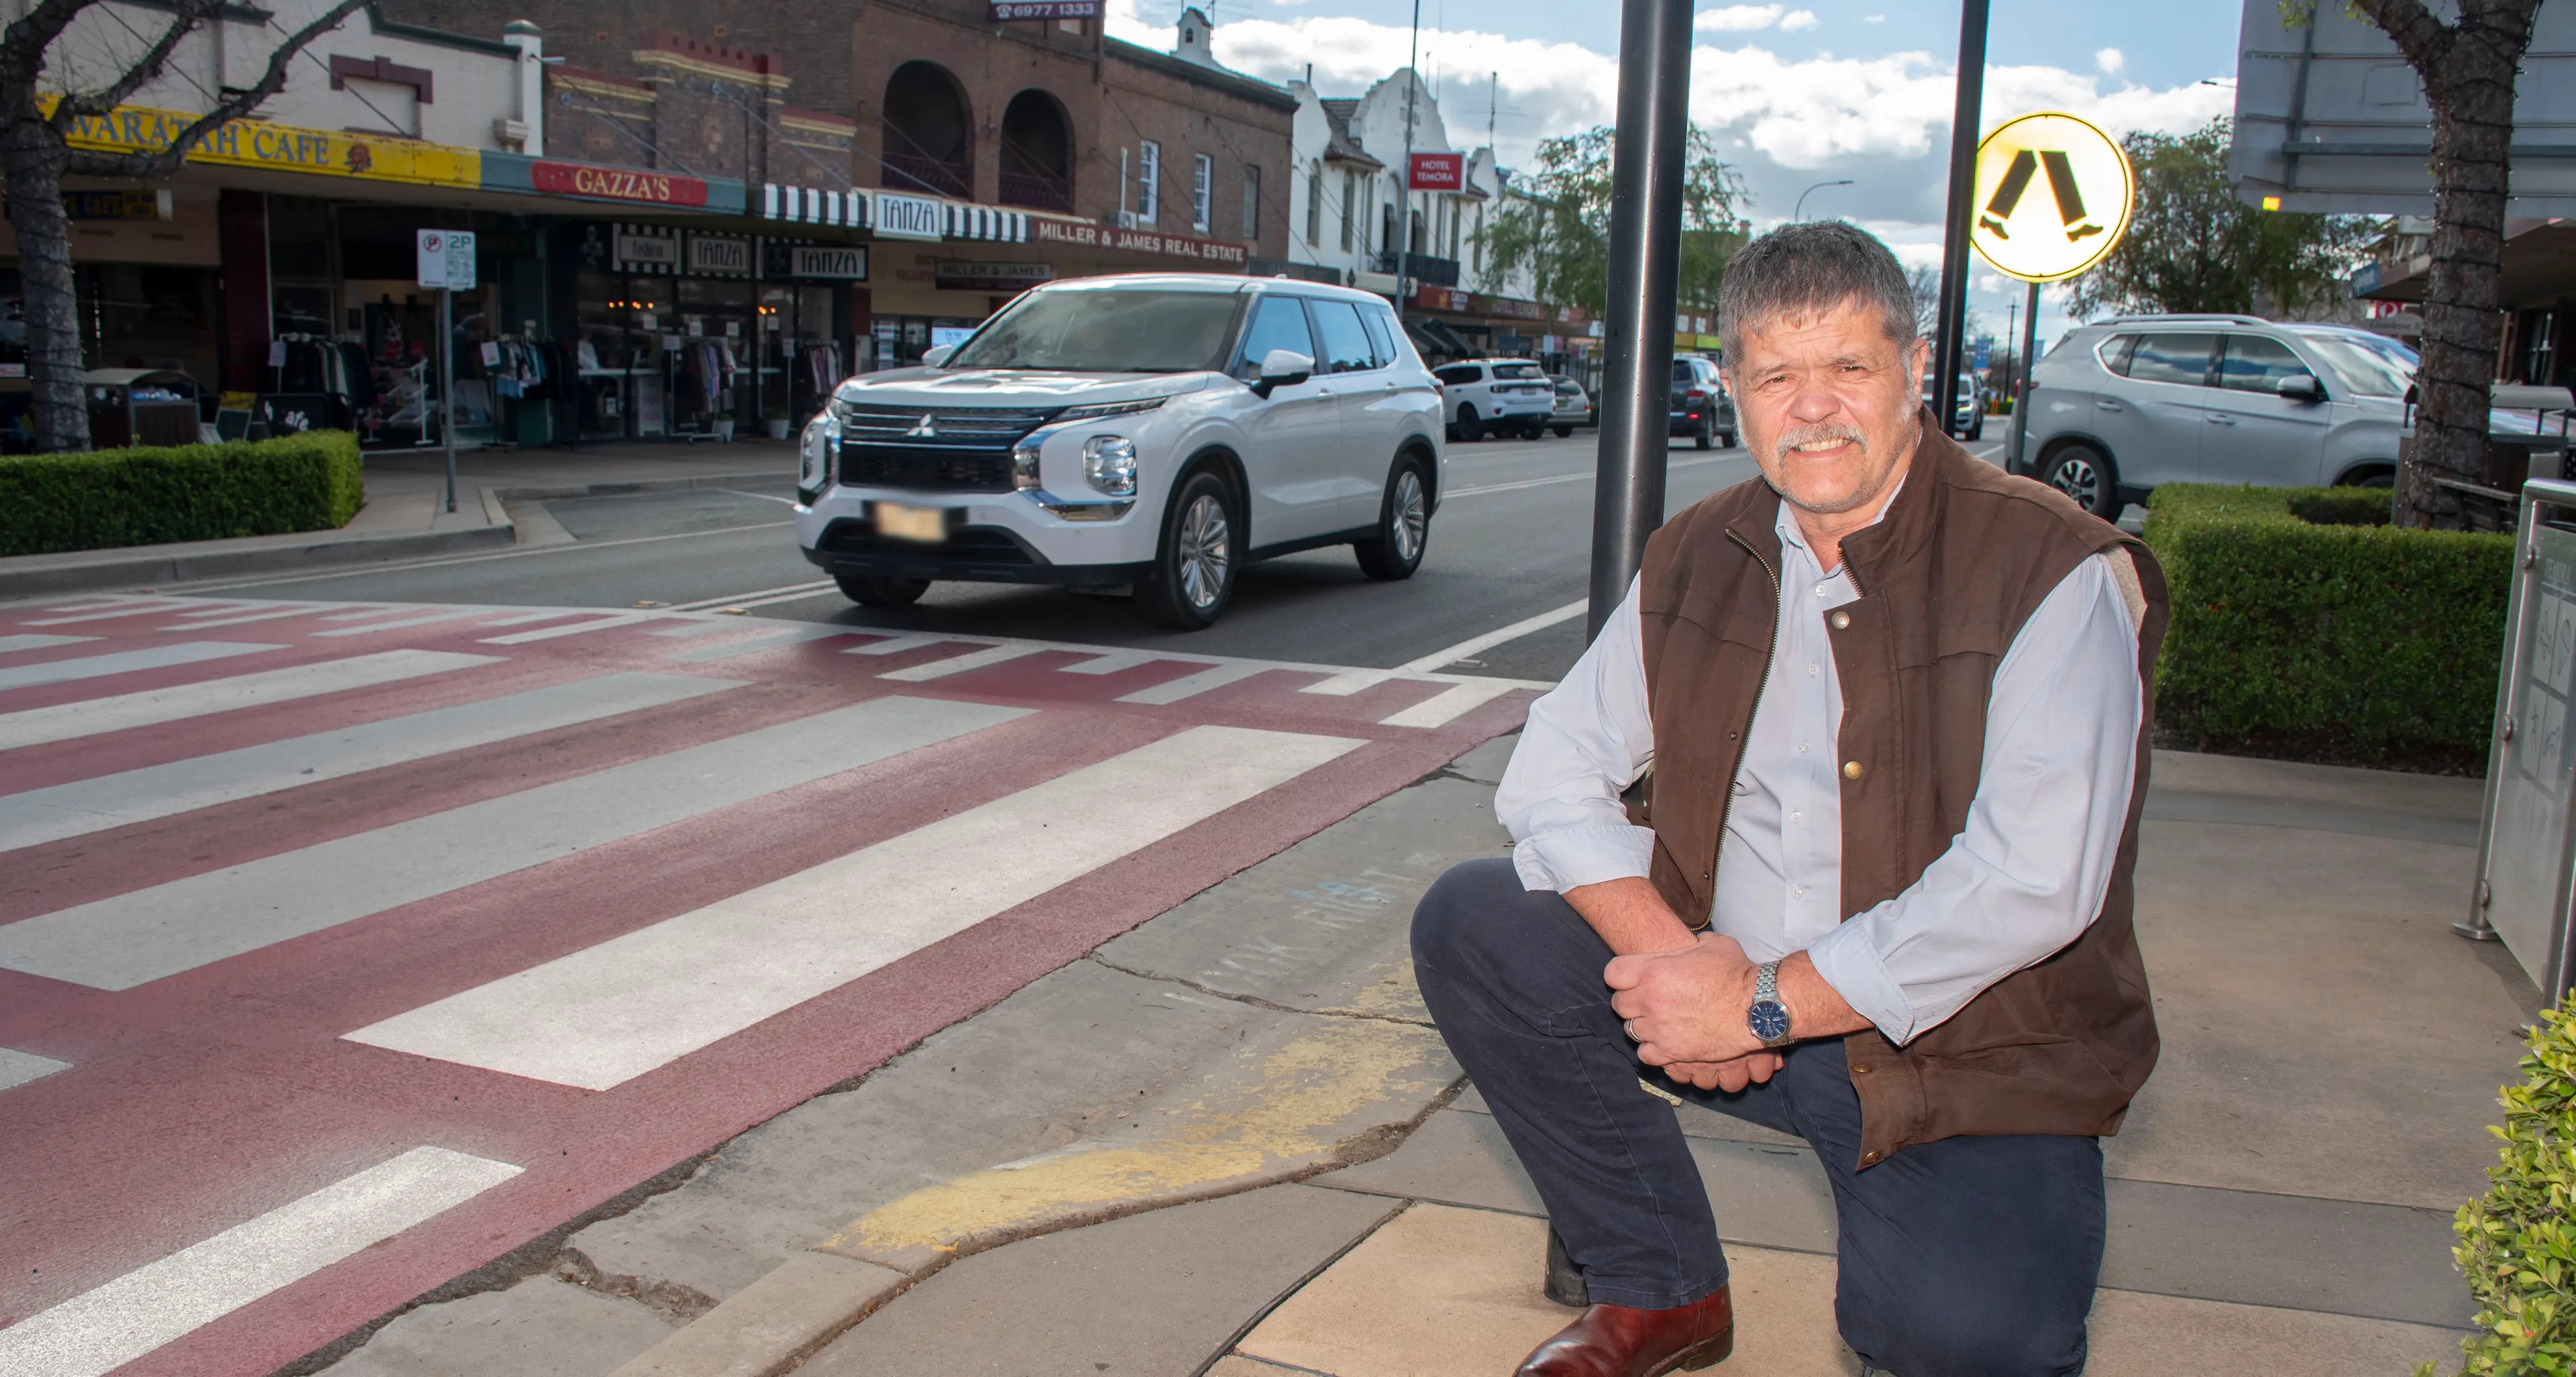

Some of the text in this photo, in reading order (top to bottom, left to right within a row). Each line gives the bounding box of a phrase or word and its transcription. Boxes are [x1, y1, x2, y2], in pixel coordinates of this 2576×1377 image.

[1014, 3, 1095, 17] 6977 1333
[254, 129, 329, 165] CAFE
[1416, 171, 1454, 182] TEMORA
[1421, 160, 1450, 170] HOTEL
[575, 168, 670, 201] GAZZA'S
[882, 198, 934, 233] TANZA
[449, 235, 472, 249] 2P
[696, 241, 743, 267] TANZA
[1038, 221, 1244, 262] MILLER & JAMES REAL ESTATE
[800, 250, 858, 277] TANZA
[943, 264, 987, 276] MILLER
[1005, 265, 1045, 277] JAMES
